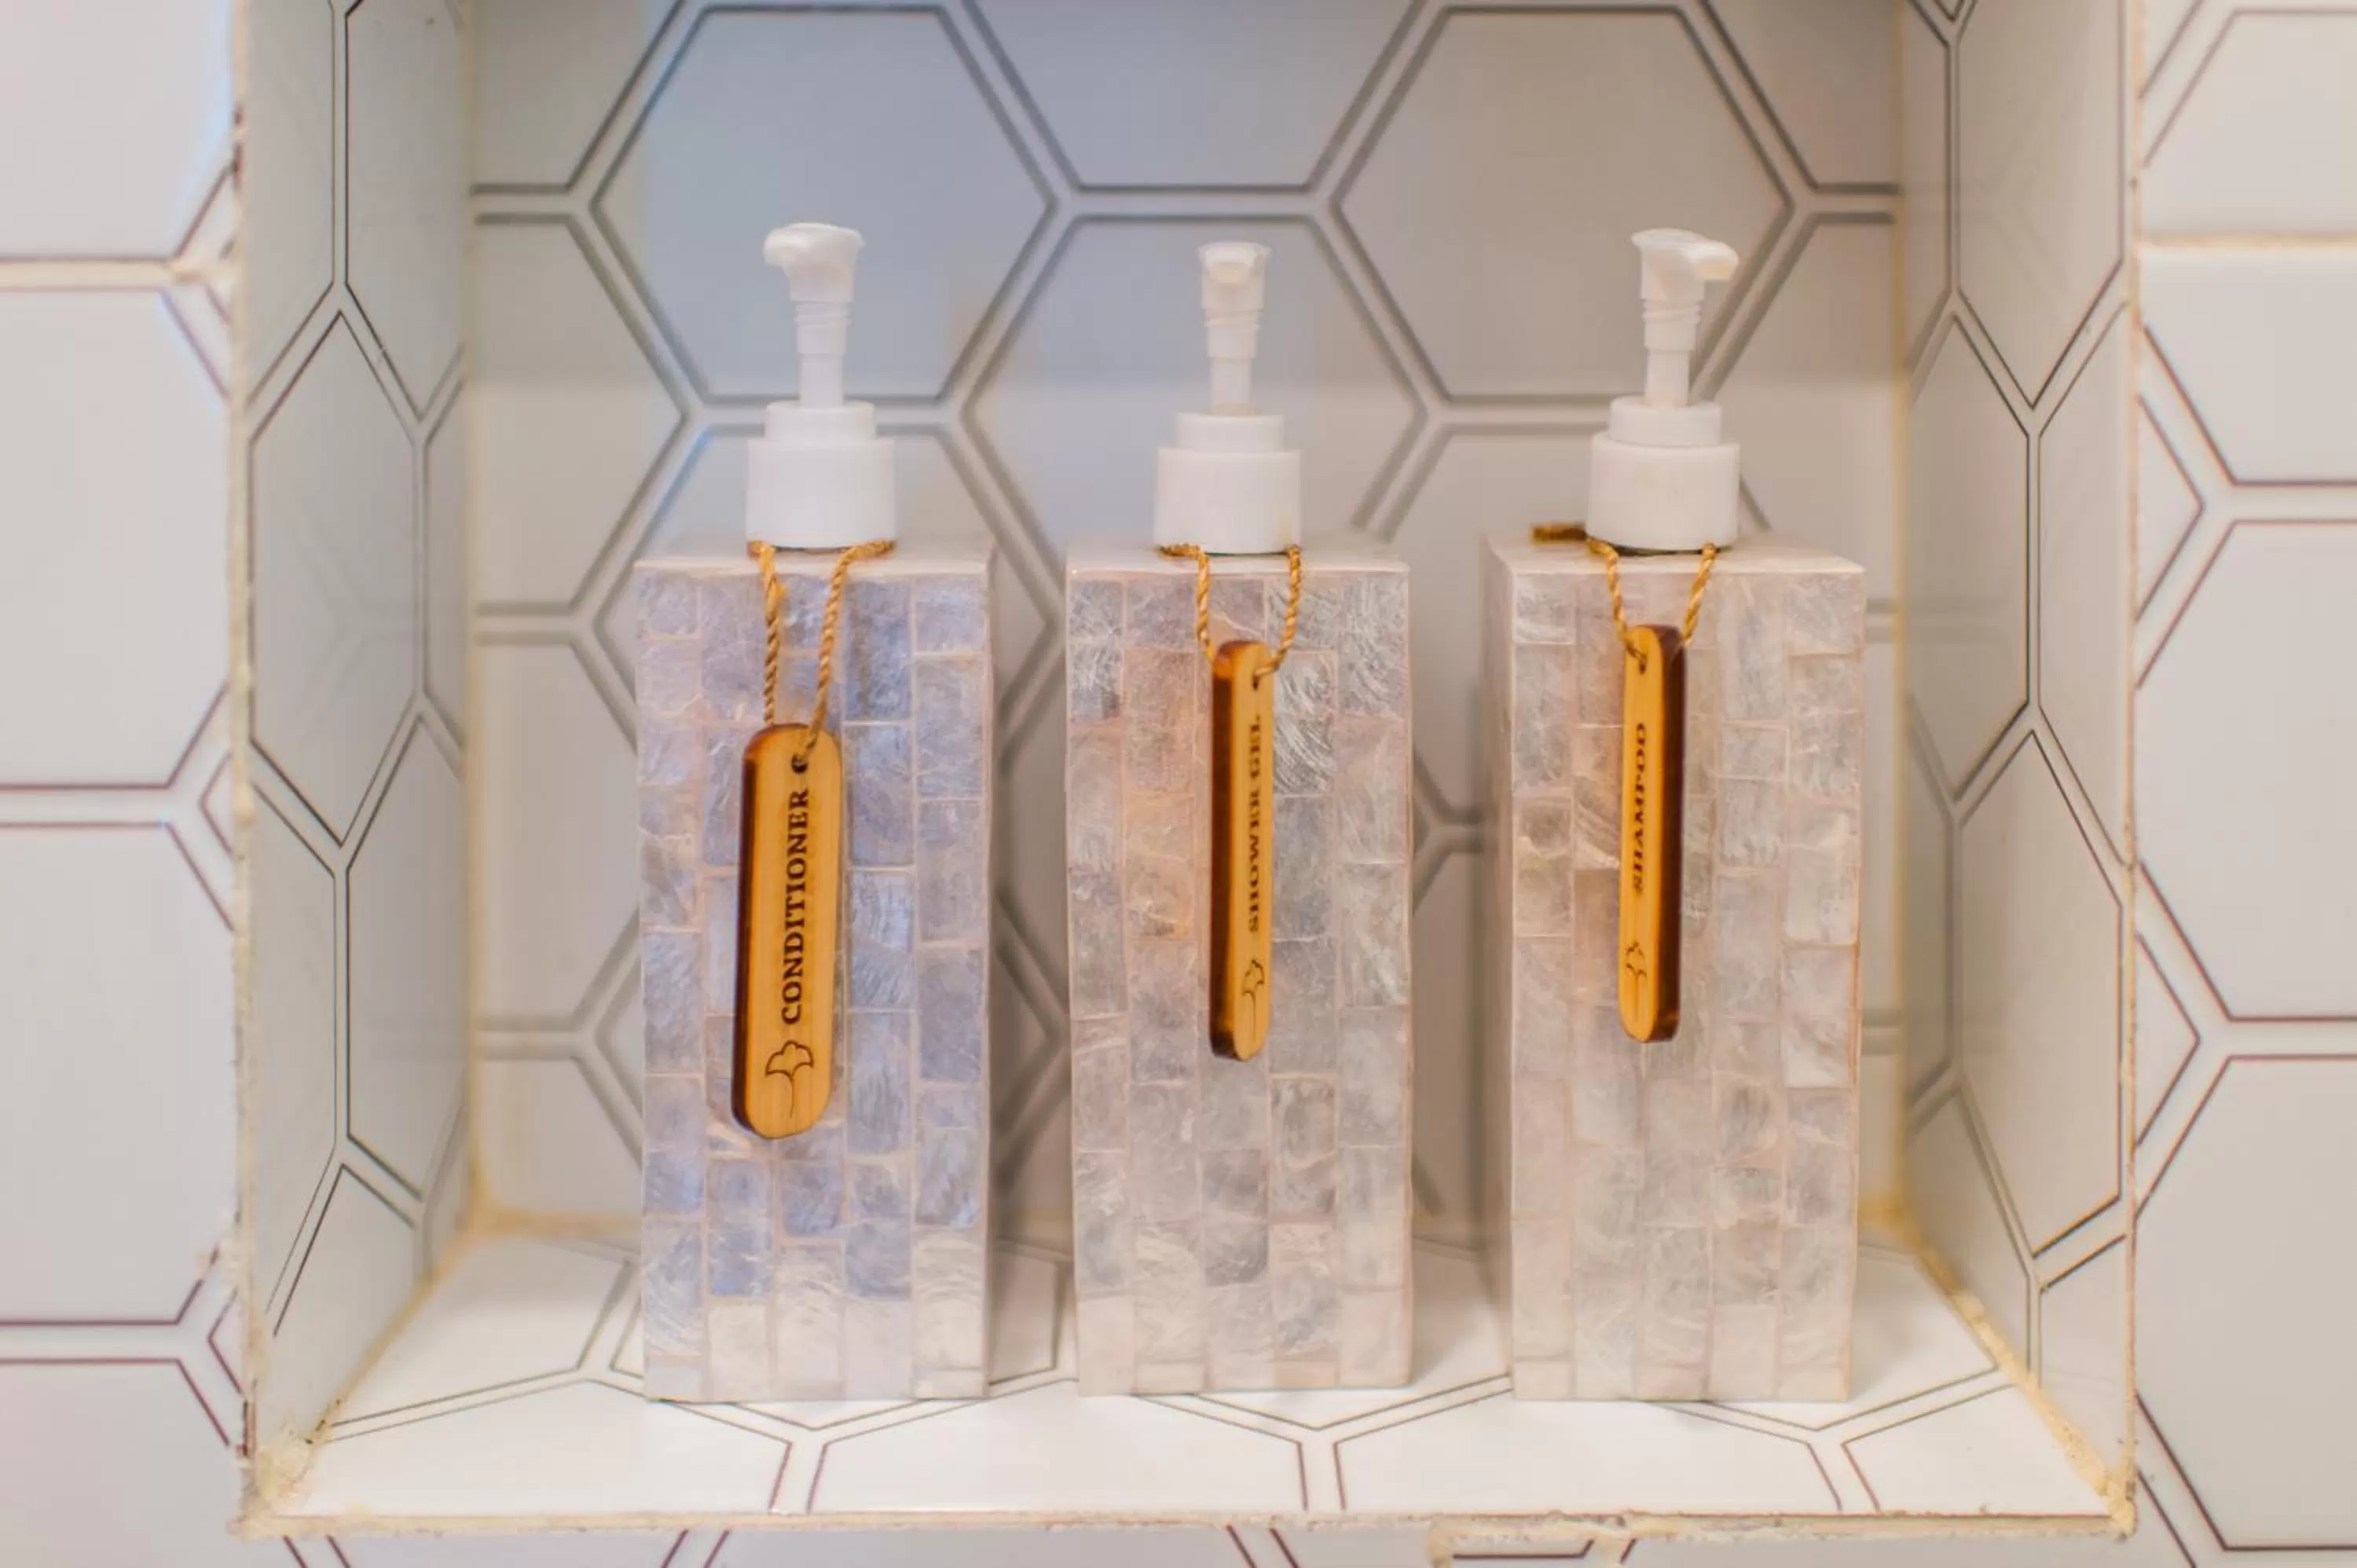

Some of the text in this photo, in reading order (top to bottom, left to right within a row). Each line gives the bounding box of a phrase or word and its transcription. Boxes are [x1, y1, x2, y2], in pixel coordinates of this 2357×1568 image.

[781, 787, 809, 1024] CONDITIONER
[1248, 715, 1261, 933] SHOWER GEL
[1633, 722, 1646, 895] SHAMPOO
